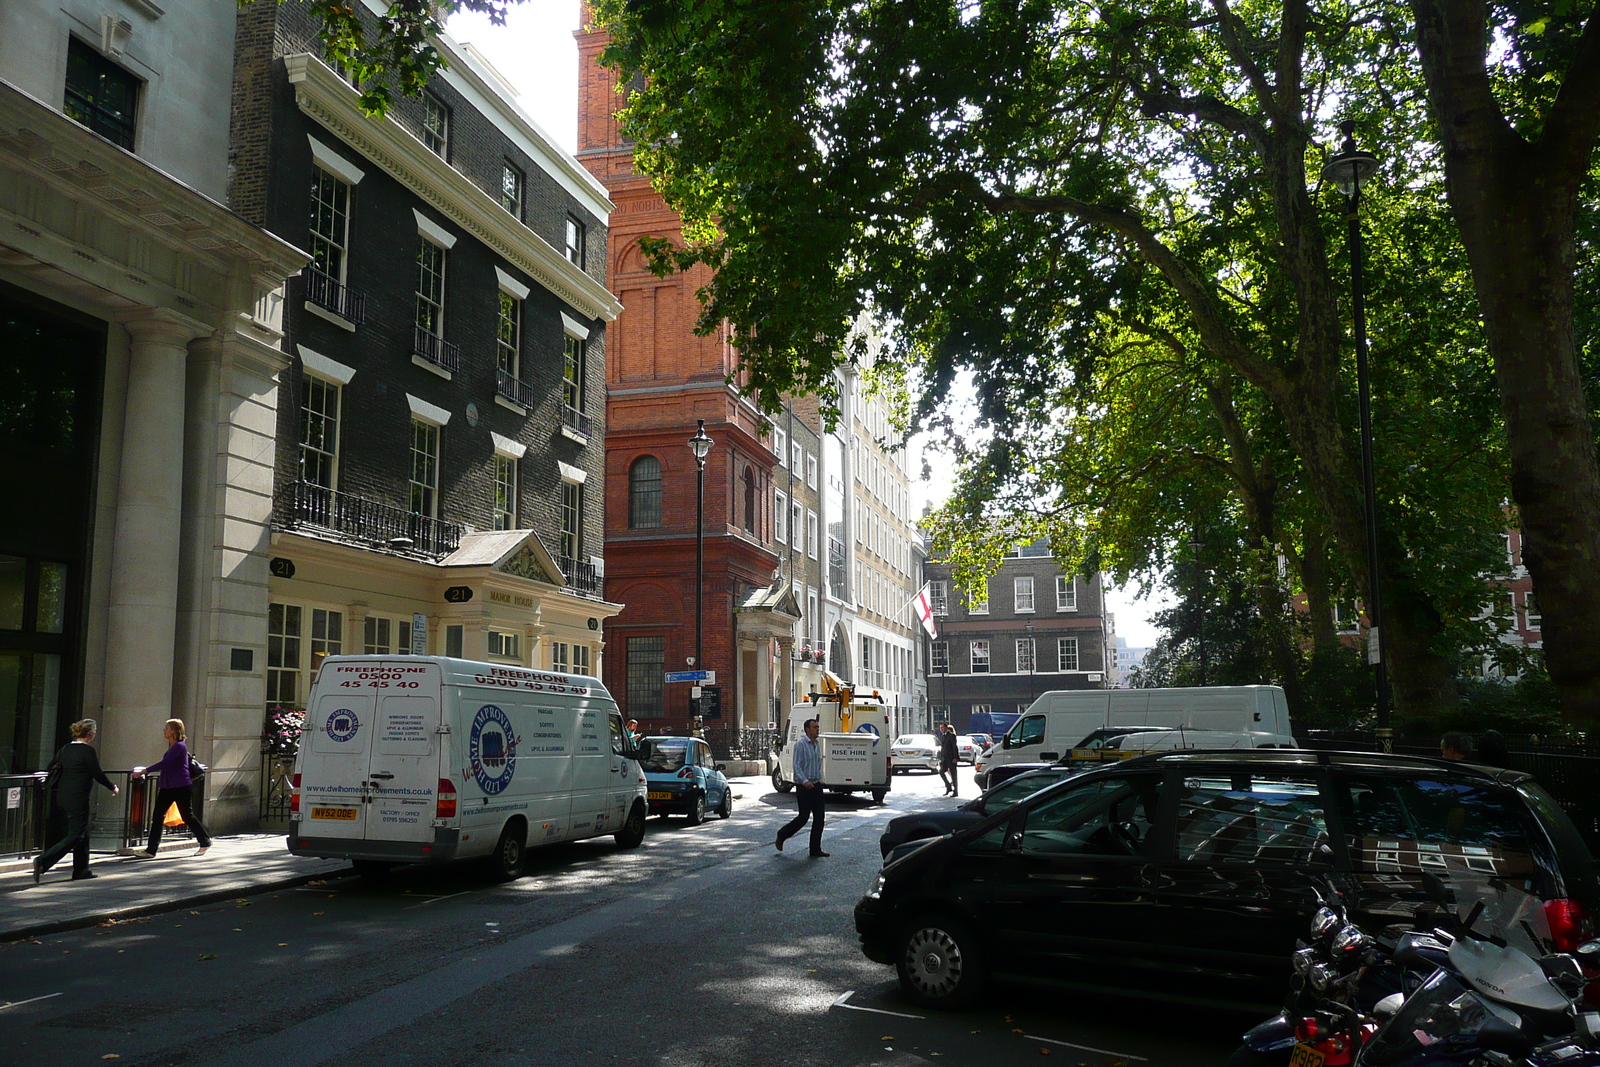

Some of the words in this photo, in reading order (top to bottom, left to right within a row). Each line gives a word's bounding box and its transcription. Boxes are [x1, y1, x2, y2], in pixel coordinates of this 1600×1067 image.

[632, 199, 664, 213] NOBIS
[276, 561, 290, 575] 21
[451, 589, 466, 600] 21
[490, 590, 512, 604] MANOR
[514, 595, 534, 608] HOUSE
[589, 619, 597, 629] 21
[490, 667, 570, 684] FREEPHONE
[396, 681, 420, 689] 40
[474, 673, 519, 688] 0500
[524, 680, 544, 691] 45
[548, 683, 567, 693] 45
[570, 685, 588, 695] 40
[474, 706, 517, 783] IMPROVEMENTS
[306, 784, 433, 797] www.dwlhomeimprovements.co.uk
[314, 808, 336, 818] NV52
[1475, 976, 1505, 995] HONDA
